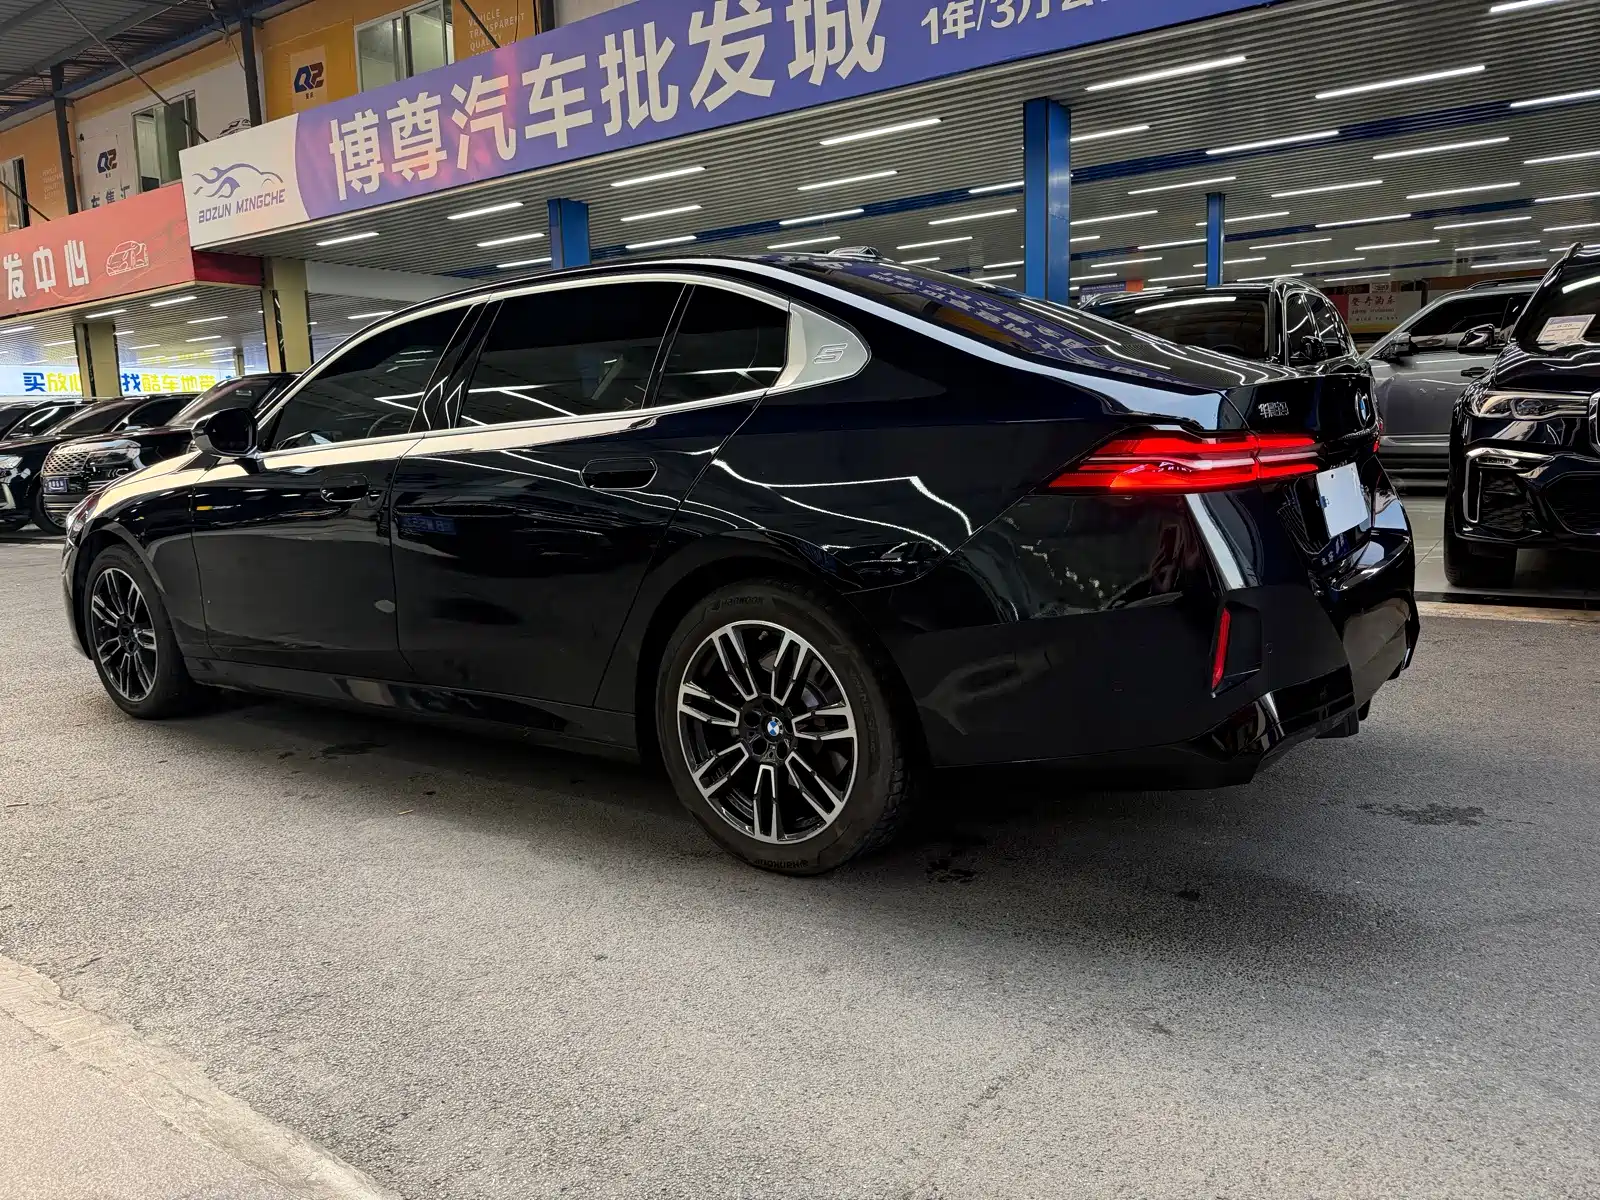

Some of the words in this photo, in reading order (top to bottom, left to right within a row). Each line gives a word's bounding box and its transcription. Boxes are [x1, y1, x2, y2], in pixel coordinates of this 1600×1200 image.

[469, 13, 525, 38] TRASPARENT
[470, 33, 502, 52] QUALTY
[329, 0, 886, 201] 博尊汽车批发城
[198, 203, 232, 224] BOZUN
[236, 189, 286, 214] MINGCHE
[3, 239, 89, 300] 发中心
[814, 343, 848, 364] 5
